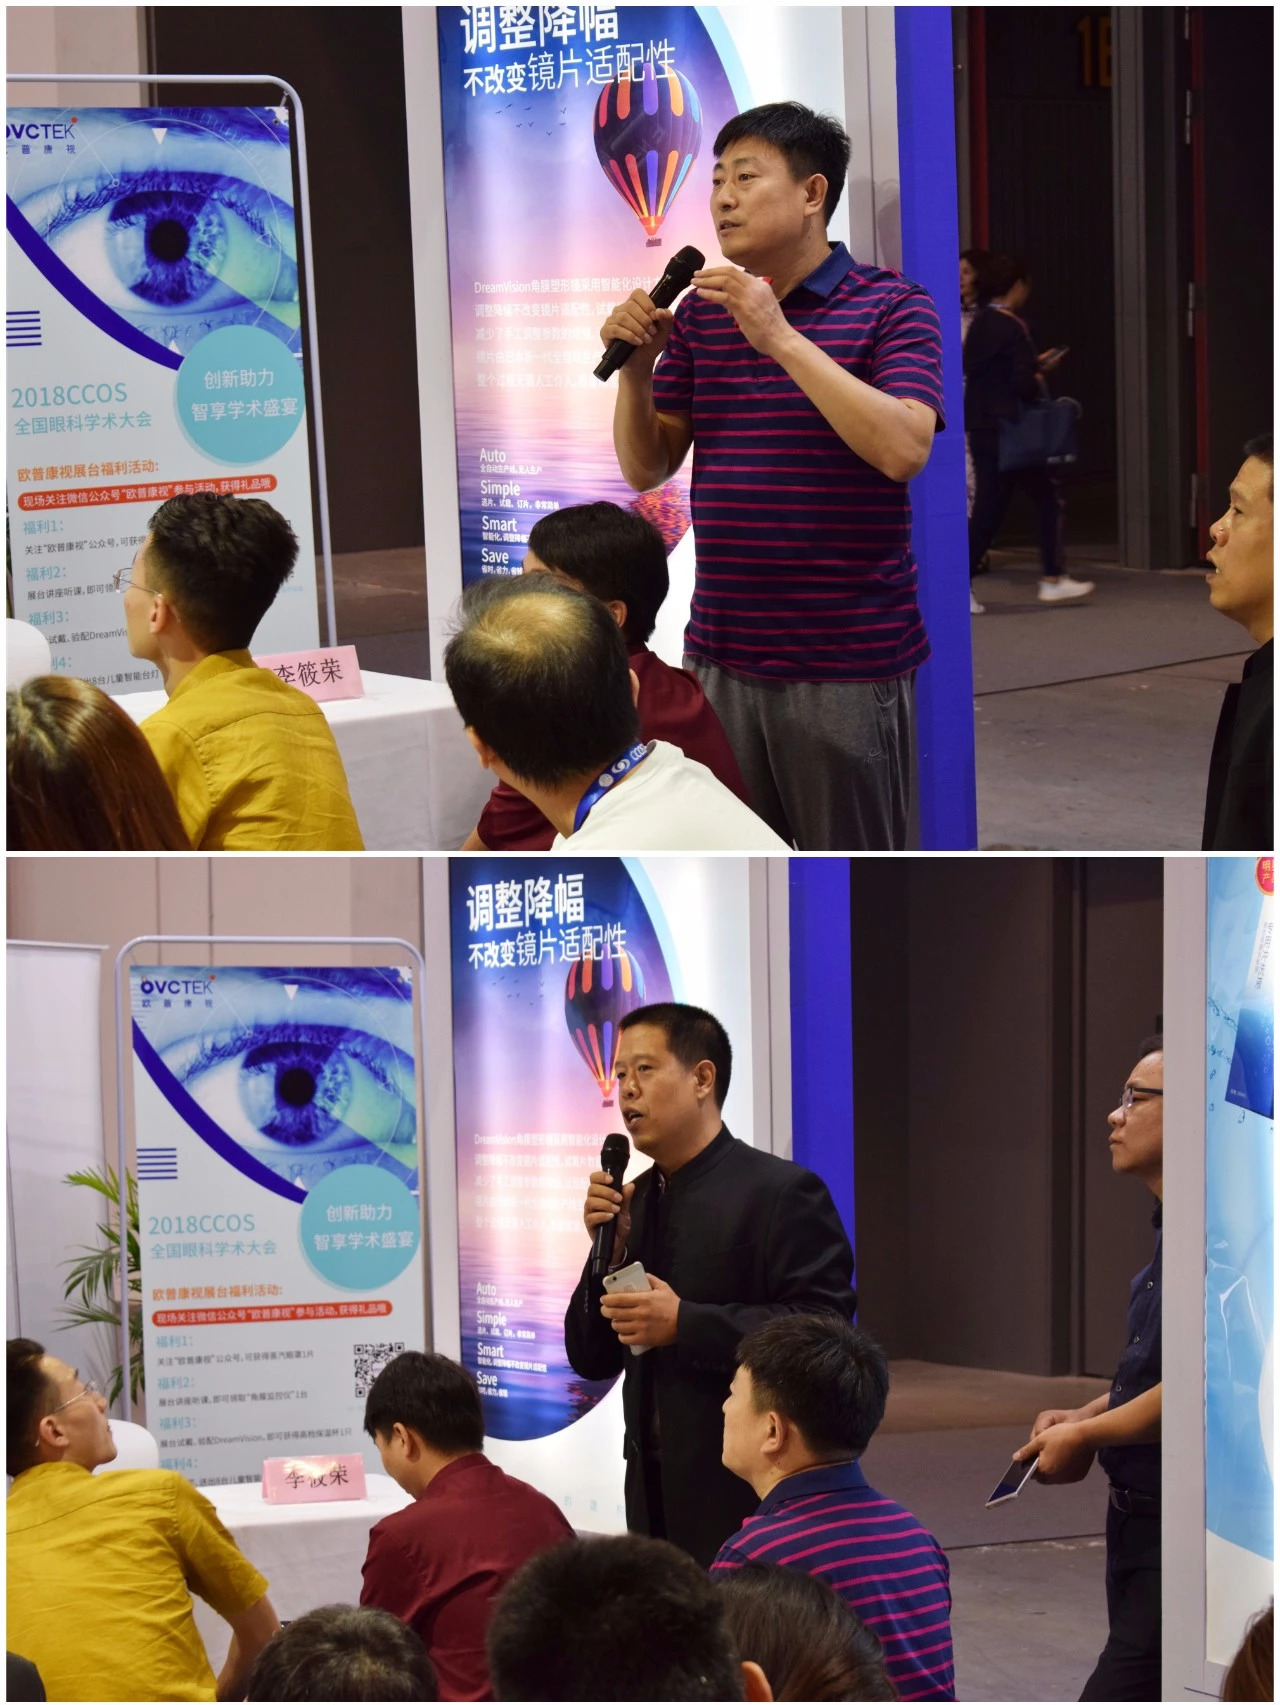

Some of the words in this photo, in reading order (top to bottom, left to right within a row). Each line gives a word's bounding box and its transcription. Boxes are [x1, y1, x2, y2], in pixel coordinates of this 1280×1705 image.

[460, 5, 619, 54] 调整降幅
[463, 38, 676, 97] 不改变镜片适配性
[203, 368, 275, 390] 创新助力
[11, 382, 128, 409] 2018CCOS
[191, 397, 299, 421] 智享学术盛宴
[14, 411, 152, 436] 全国眼科学术大会
[480, 447, 506, 462] Auto
[17, 459, 160, 482] 欧普康视展台福利活动：
[480, 479, 521, 498] Simple
[23, 520, 64, 535] 福利1：
[482, 515, 518, 532] Smart
[481, 547, 509, 563] Save
[26, 566, 67, 582] 福利2：
[28, 610, 70, 626] 福利3：
[273, 657, 344, 687] 李筱荣
[466, 873, 585, 932] 调整降幅
[468, 921, 627, 970] 不改变镜片适配性
[140, 979, 213, 995] OVCTEK
[326, 1204, 392, 1223] 创新助力
[148, 1213, 256, 1235] 2018CCOS
[150, 1239, 277, 1260] 全国眼科学术大会
[313, 1230, 414, 1251] 智享学术盛宴
[476, 1281, 497, 1295] Auto
[477, 1310, 507, 1327] Simple
[477, 1341, 504, 1358] Smart
[476, 1370, 498, 1386] Save
